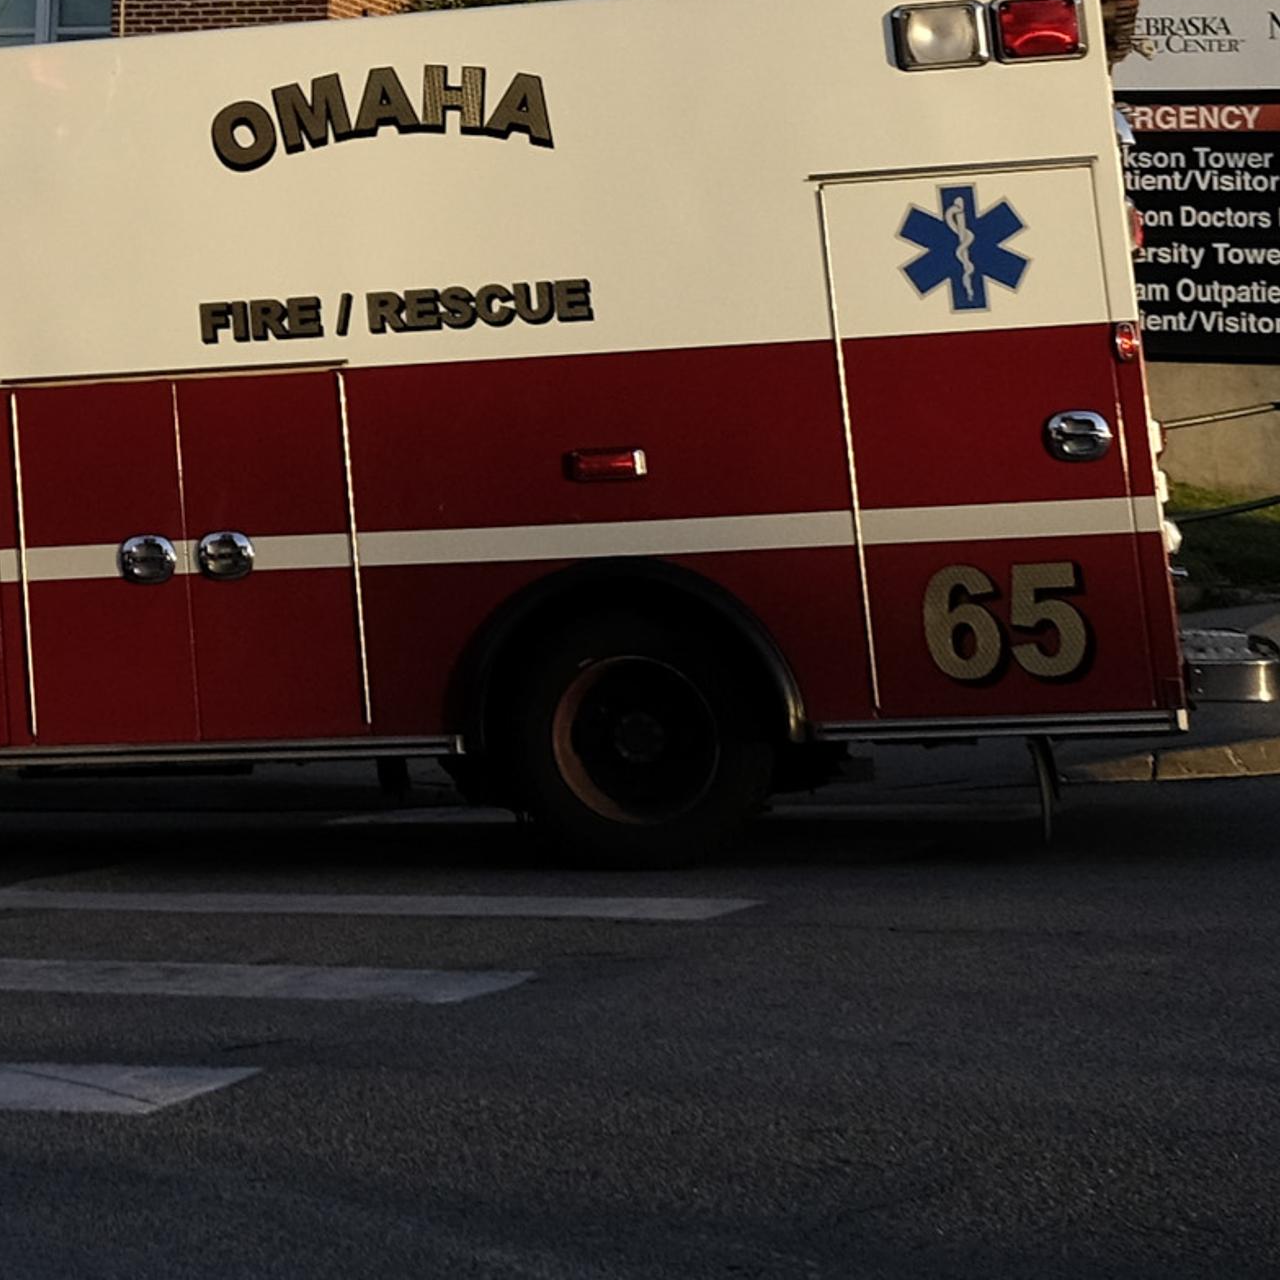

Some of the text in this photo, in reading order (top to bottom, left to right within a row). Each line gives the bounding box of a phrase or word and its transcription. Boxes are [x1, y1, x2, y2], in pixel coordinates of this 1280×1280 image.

[211, 64, 554, 172] OMAHA
[1192, 146, 1274, 169] Tower
[1180, 205, 1272, 228] Doctors
[199, 296, 324, 345] FIRE
[366, 278, 594, 334] RESCUE
[922, 562, 1092, 686] 65
